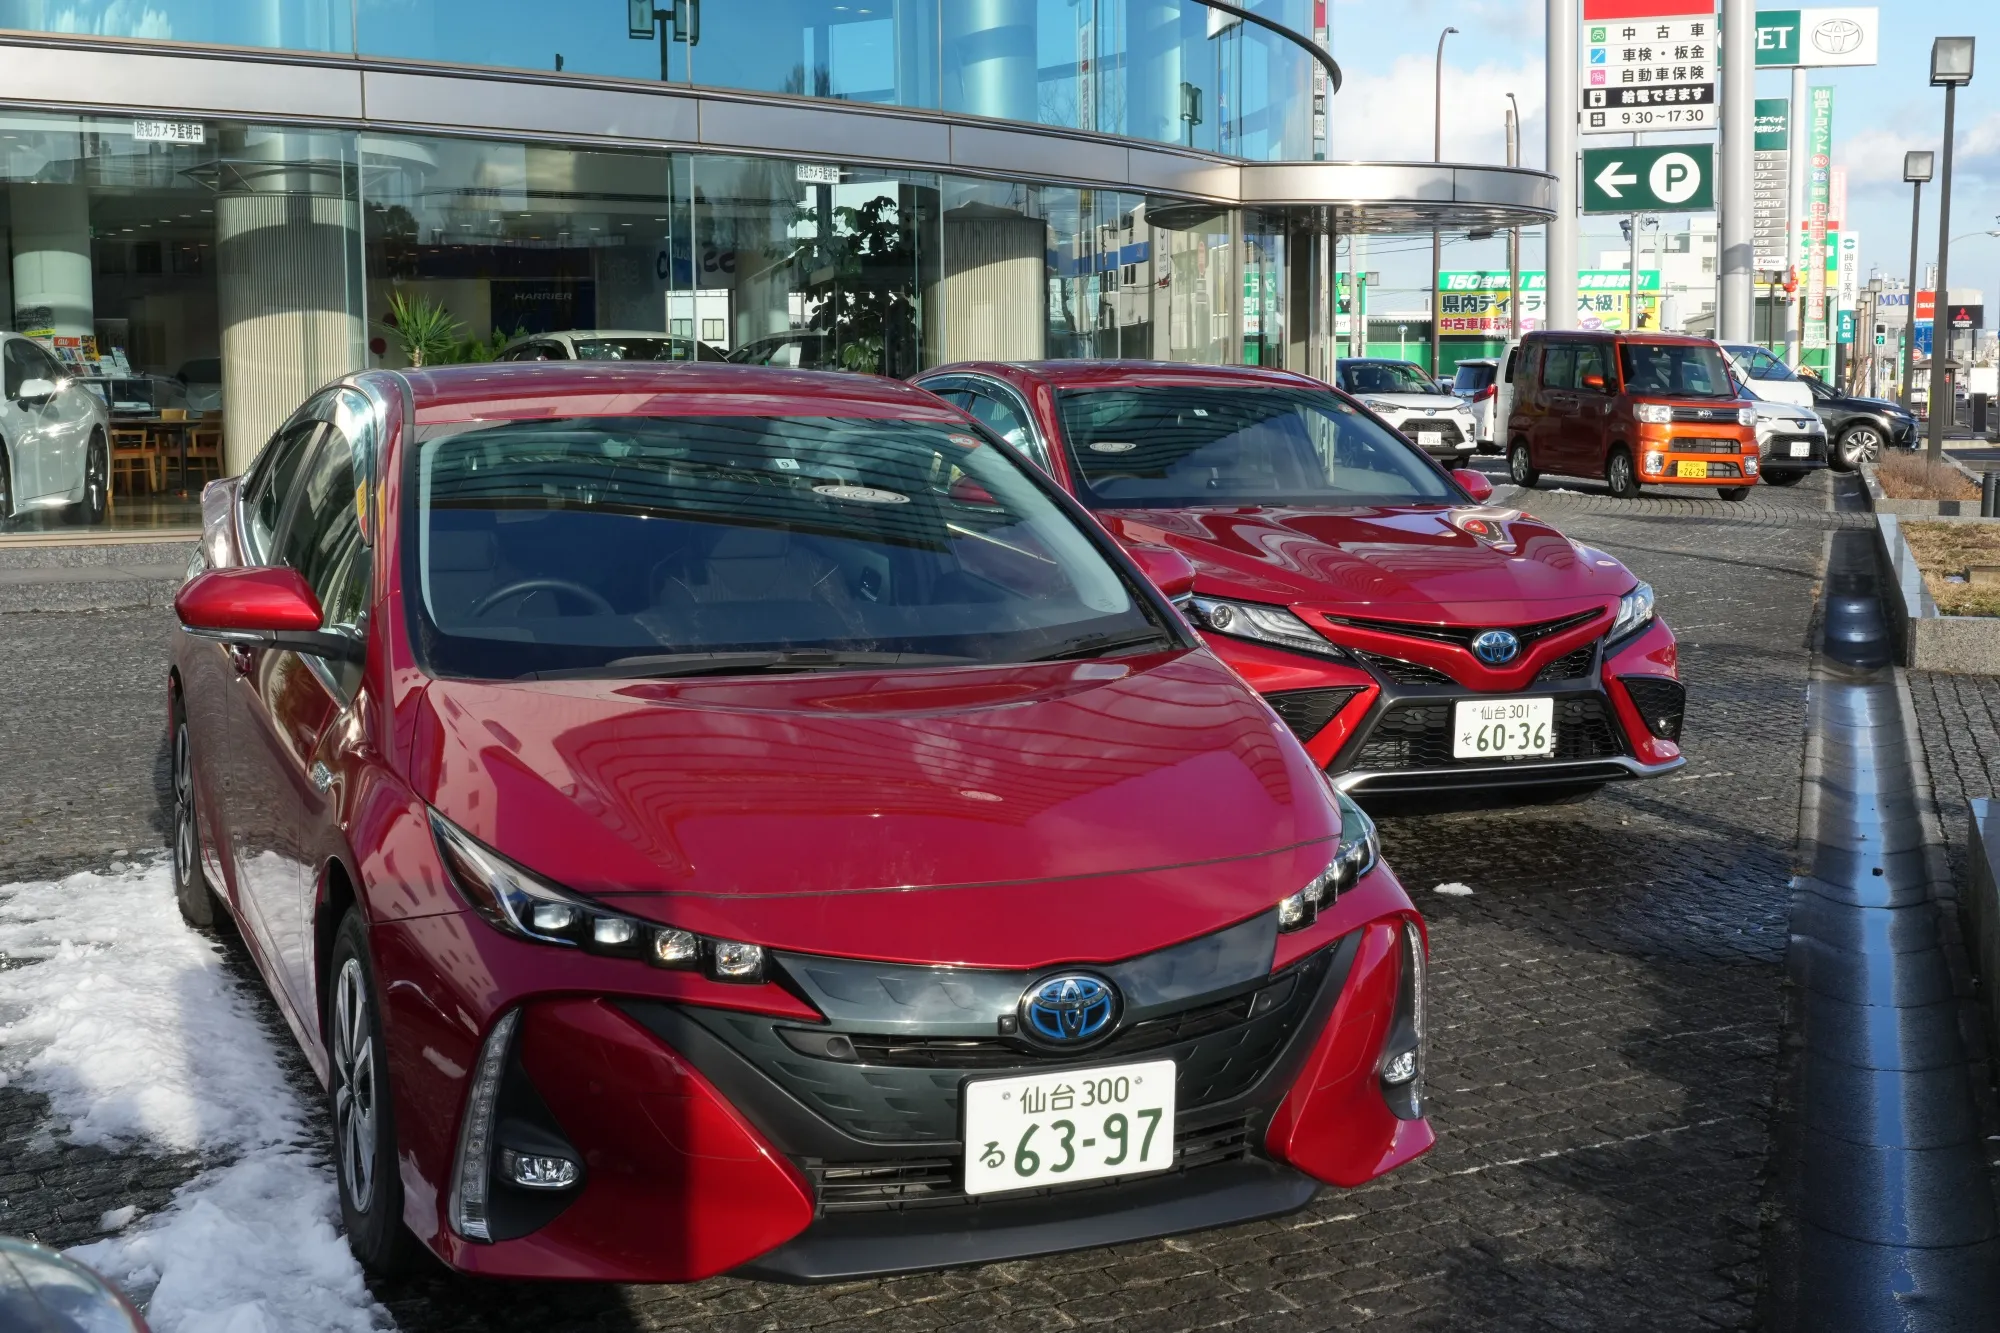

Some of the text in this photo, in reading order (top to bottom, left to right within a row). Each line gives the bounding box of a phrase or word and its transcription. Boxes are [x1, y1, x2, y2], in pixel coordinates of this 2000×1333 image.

[1622, 45, 1705, 62] 車検・板金
[1622, 65, 1705, 83] 自動車保険
[1621, 87, 1705, 104] 給電できます
[137, 121, 201, 140] 防犯カメラ監視中
[1666, 163, 1688, 192] P
[514, 293, 573, 301] HARRIER
[1842, 315, 1851, 330] 入口
[57, 338, 69, 346] au
[1683, 467, 1705, 477] 26-29
[1462, 722, 1546, 752] そ 60-36
[1019, 1076, 1130, 1114] 仙台300
[979, 1107, 1163, 1178] る 63-97
